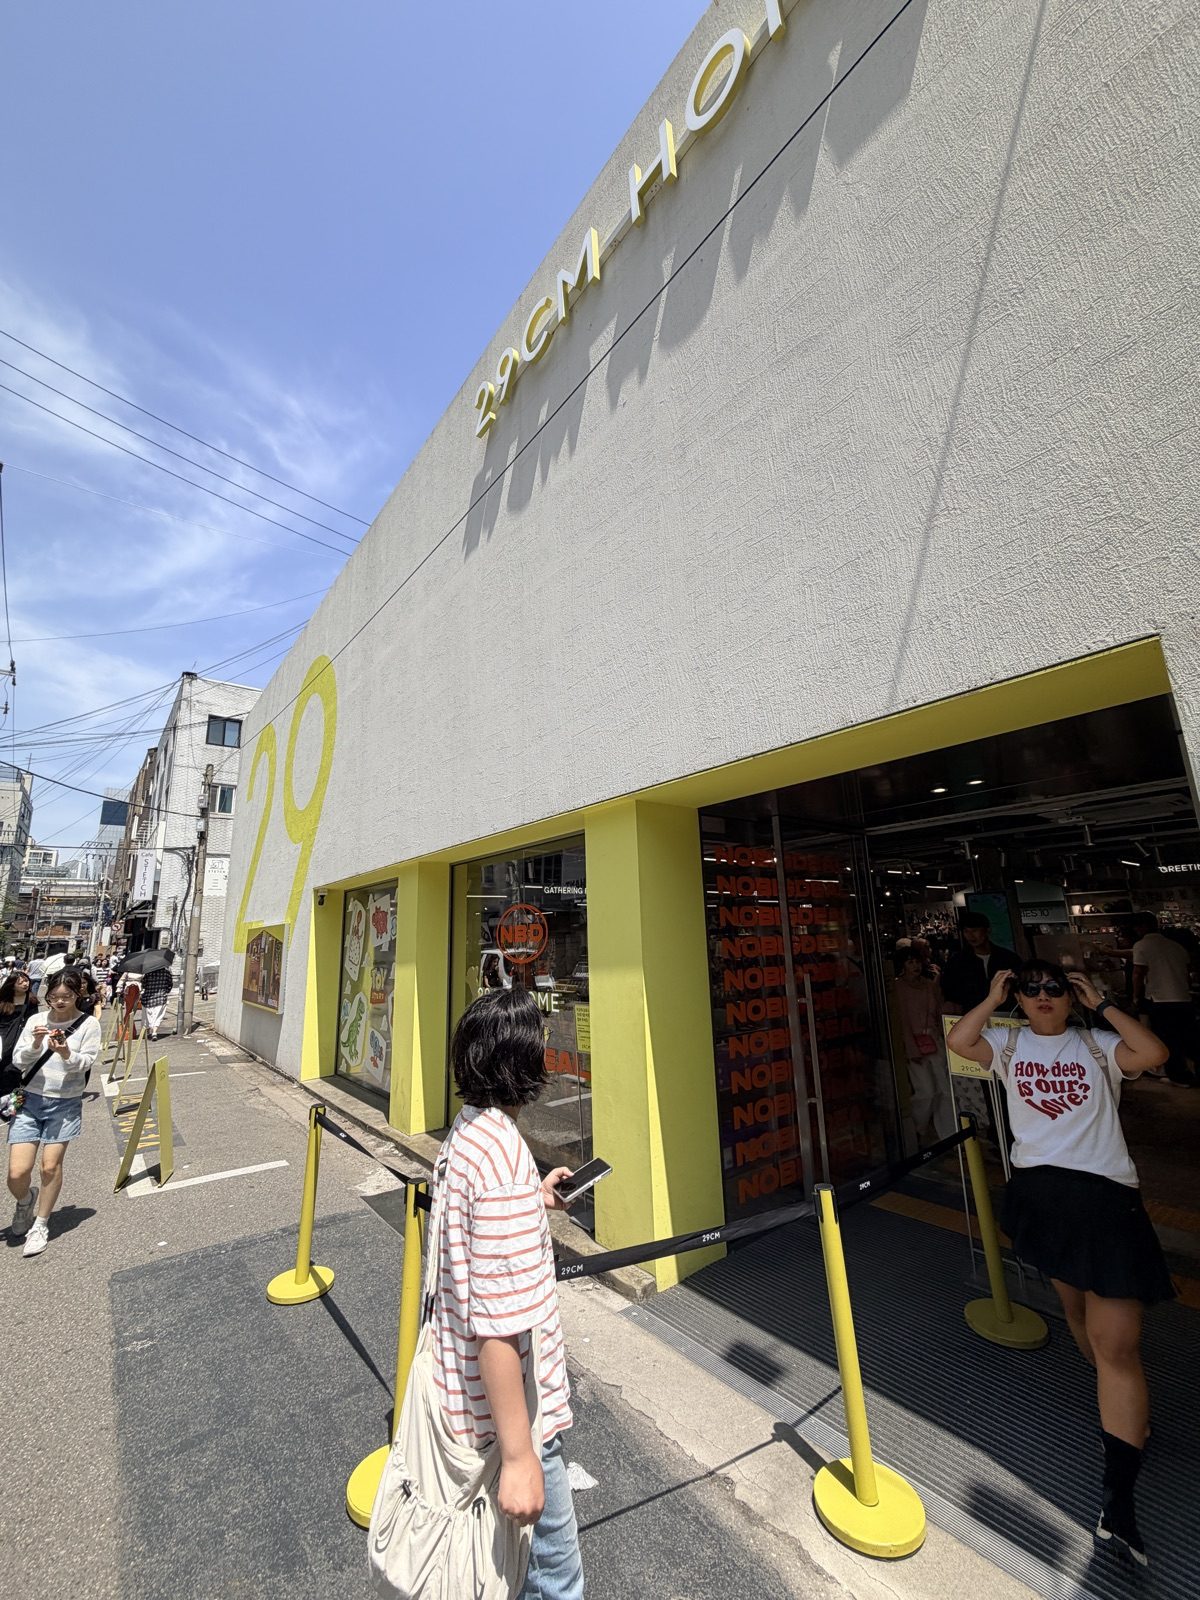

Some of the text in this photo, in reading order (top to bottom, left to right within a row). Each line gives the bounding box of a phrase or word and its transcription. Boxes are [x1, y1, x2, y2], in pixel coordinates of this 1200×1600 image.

[473, 226, 601, 438] 29CM
[234, 655, 337, 953] 29
[543, 886, 583, 895] GATHERING
[500, 924, 544, 945] NBD
[371, 967, 387, 991] TOY
[960, 1064, 981, 1073] 29CM
[1014, 1061, 1086, 1080] How deep
[1017, 1078, 1079, 1097] is our
[1025, 1083, 1091, 1121] love?
[702, 1231, 721, 1242] 29CM
[561, 1264, 584, 1275] 29CM
